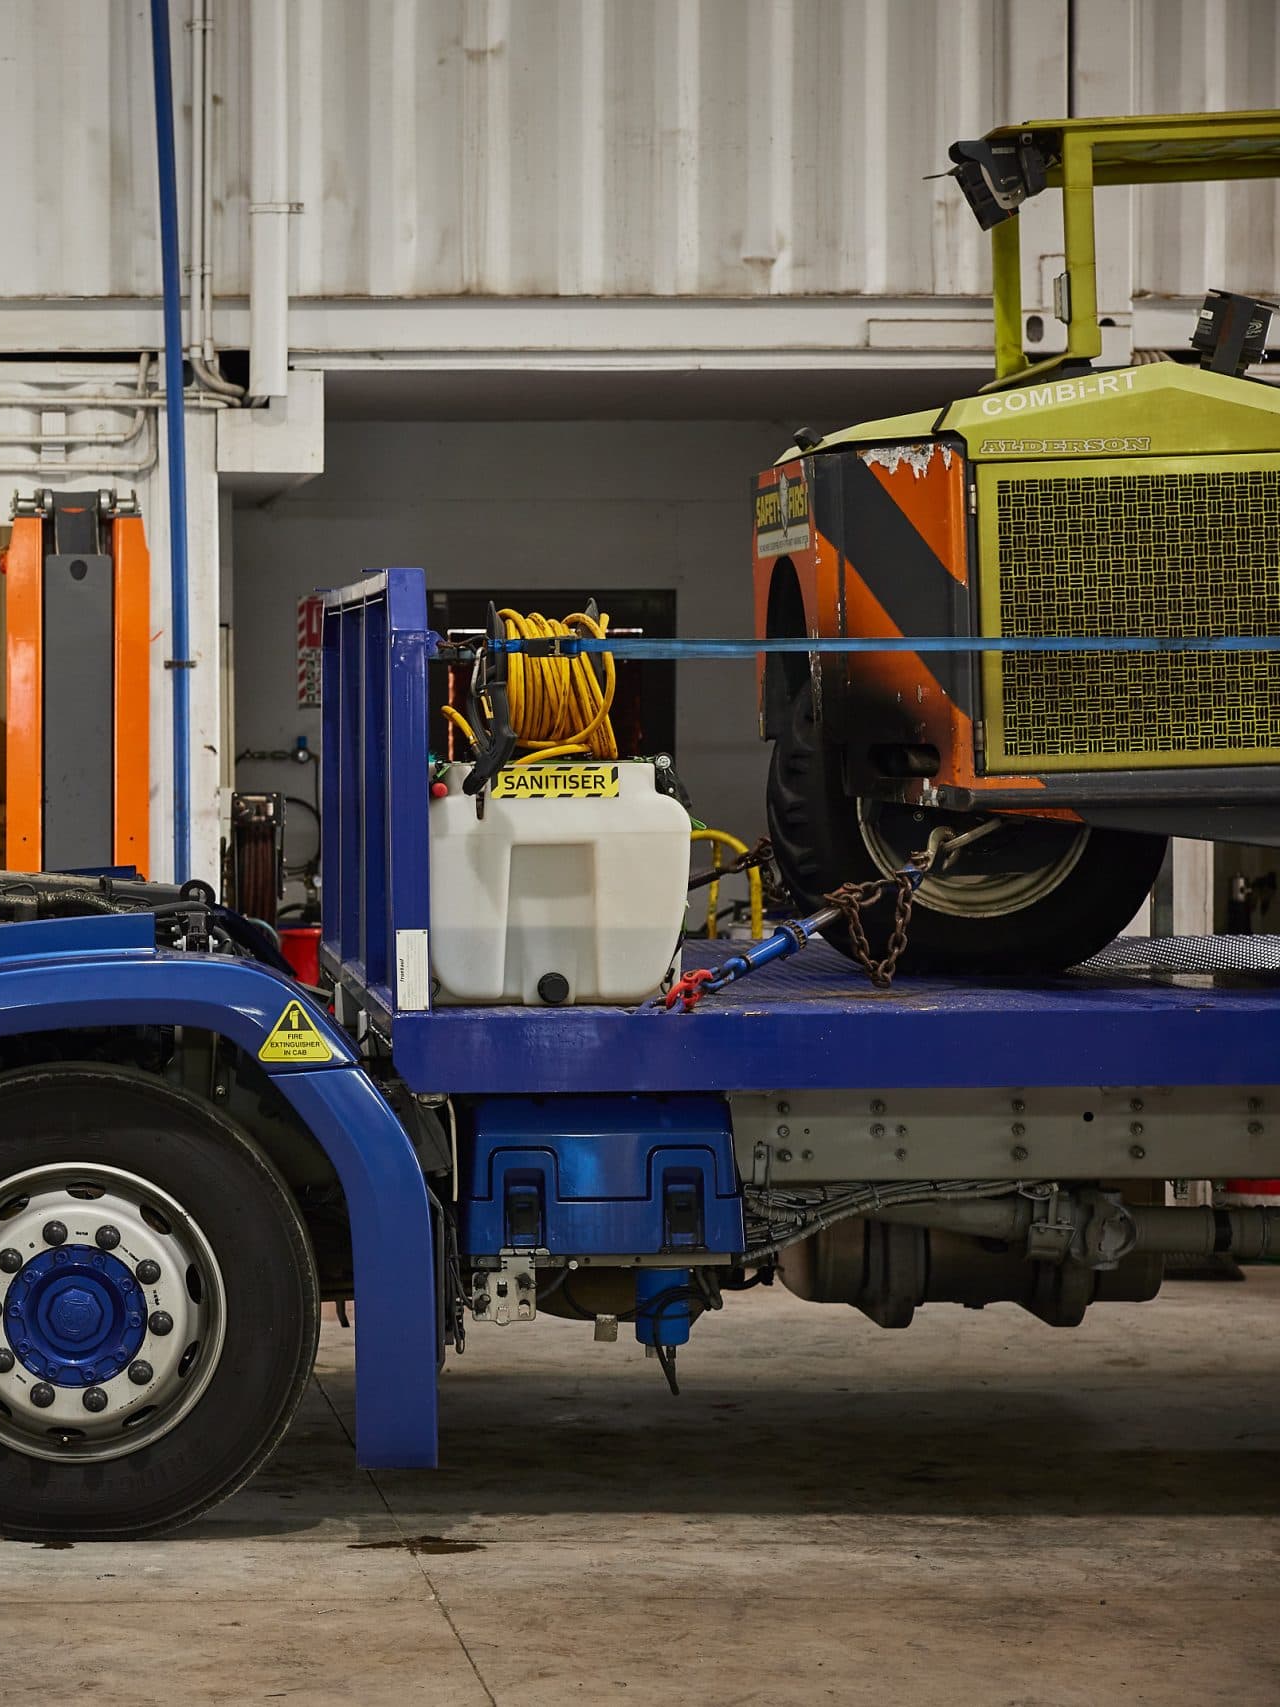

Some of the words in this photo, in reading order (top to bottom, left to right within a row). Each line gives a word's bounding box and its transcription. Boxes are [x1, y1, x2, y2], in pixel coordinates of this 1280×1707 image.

[981, 437, 1151, 455] ALDERSON
[788, 482, 808, 519] FIRST
[504, 774, 606, 790] SANITISER
